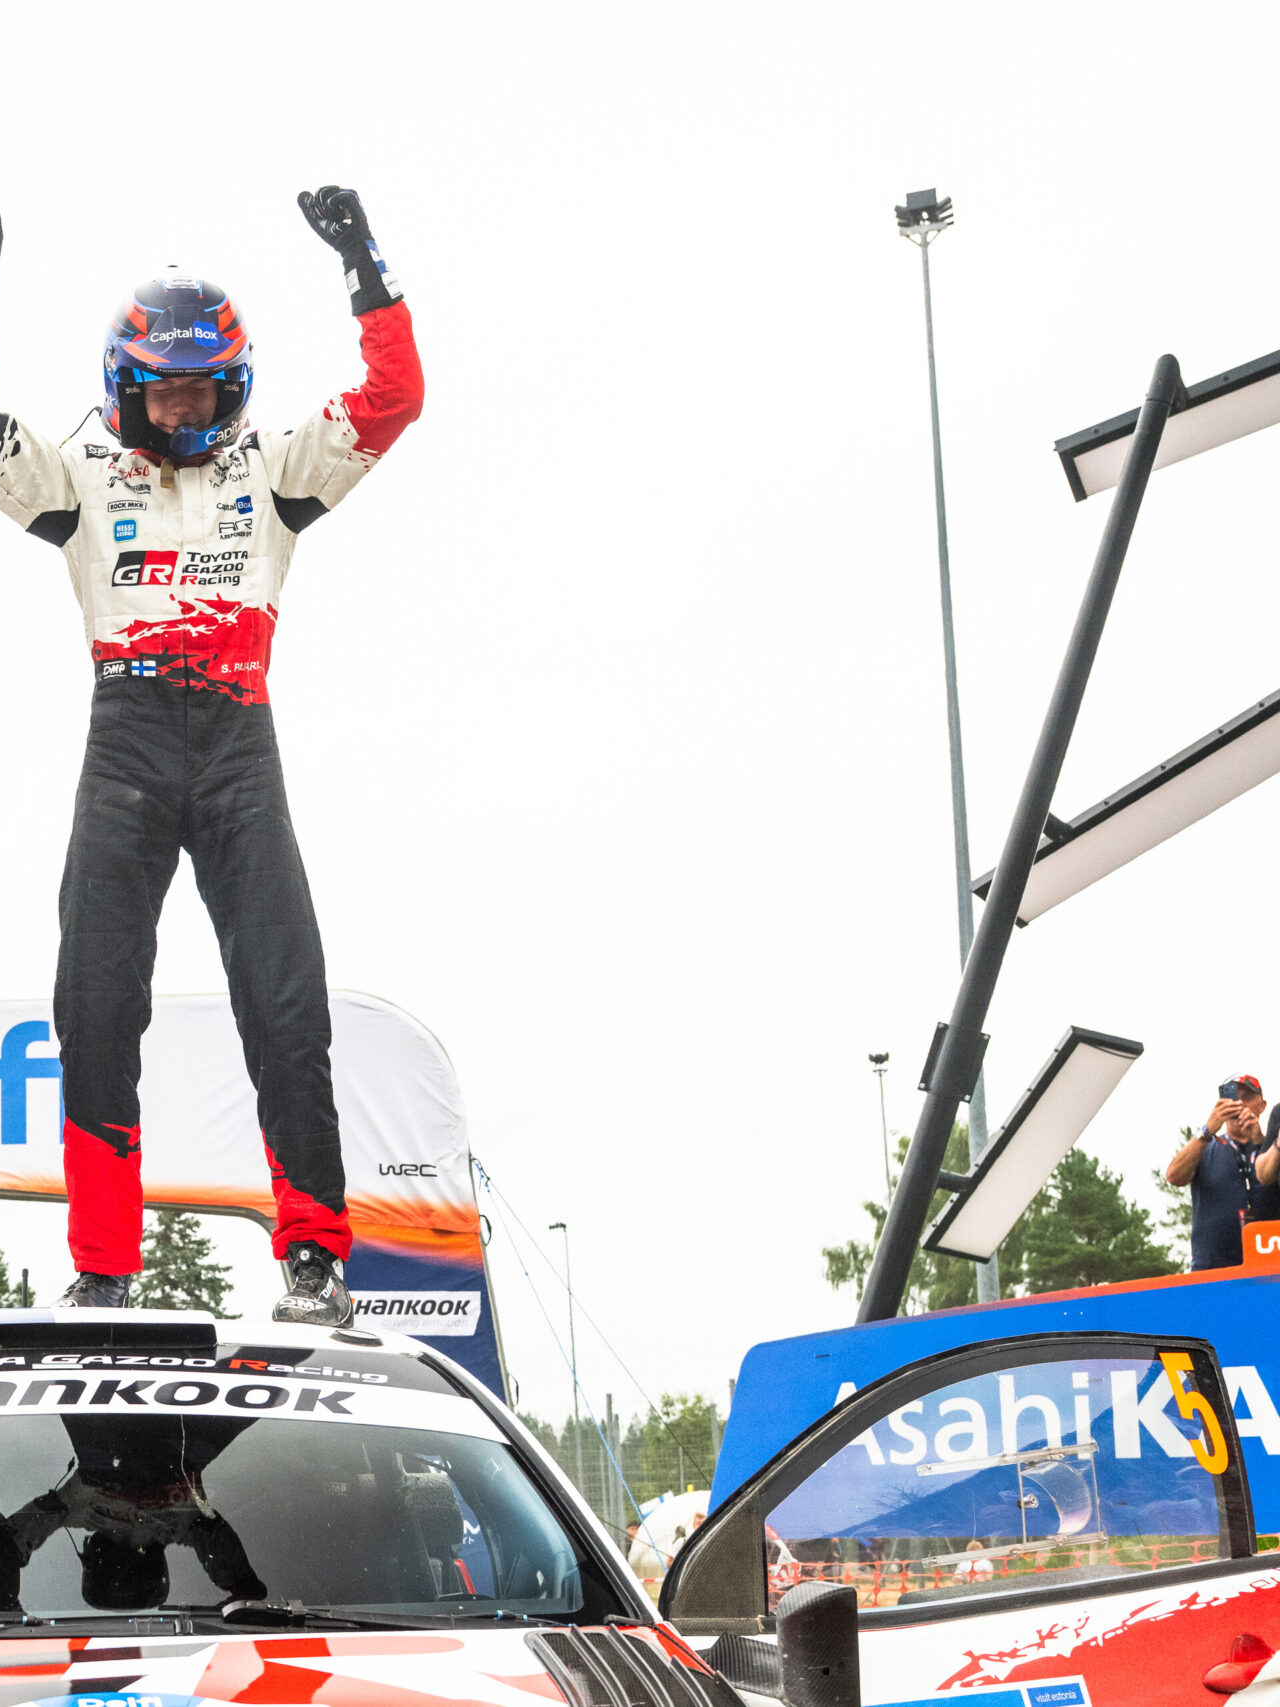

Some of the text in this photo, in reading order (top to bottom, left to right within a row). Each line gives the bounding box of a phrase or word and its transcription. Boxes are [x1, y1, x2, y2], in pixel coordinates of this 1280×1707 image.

[150, 327, 217, 342] Capital Box
[187, 551, 248, 563] TOYOTA
[113, 565, 173, 585] GR
[183, 563, 244, 574] GAZOO
[180, 574, 240, 587] Racing
[221, 664, 232, 674] S.
[378, 1163, 438, 1178] WRC
[40, 1353, 216, 1368] GAZOO
[228, 1358, 388, 1384] Racing
[1160, 1352, 1229, 1476] 5
[1035, 1690, 1077, 1703] visit estonia
